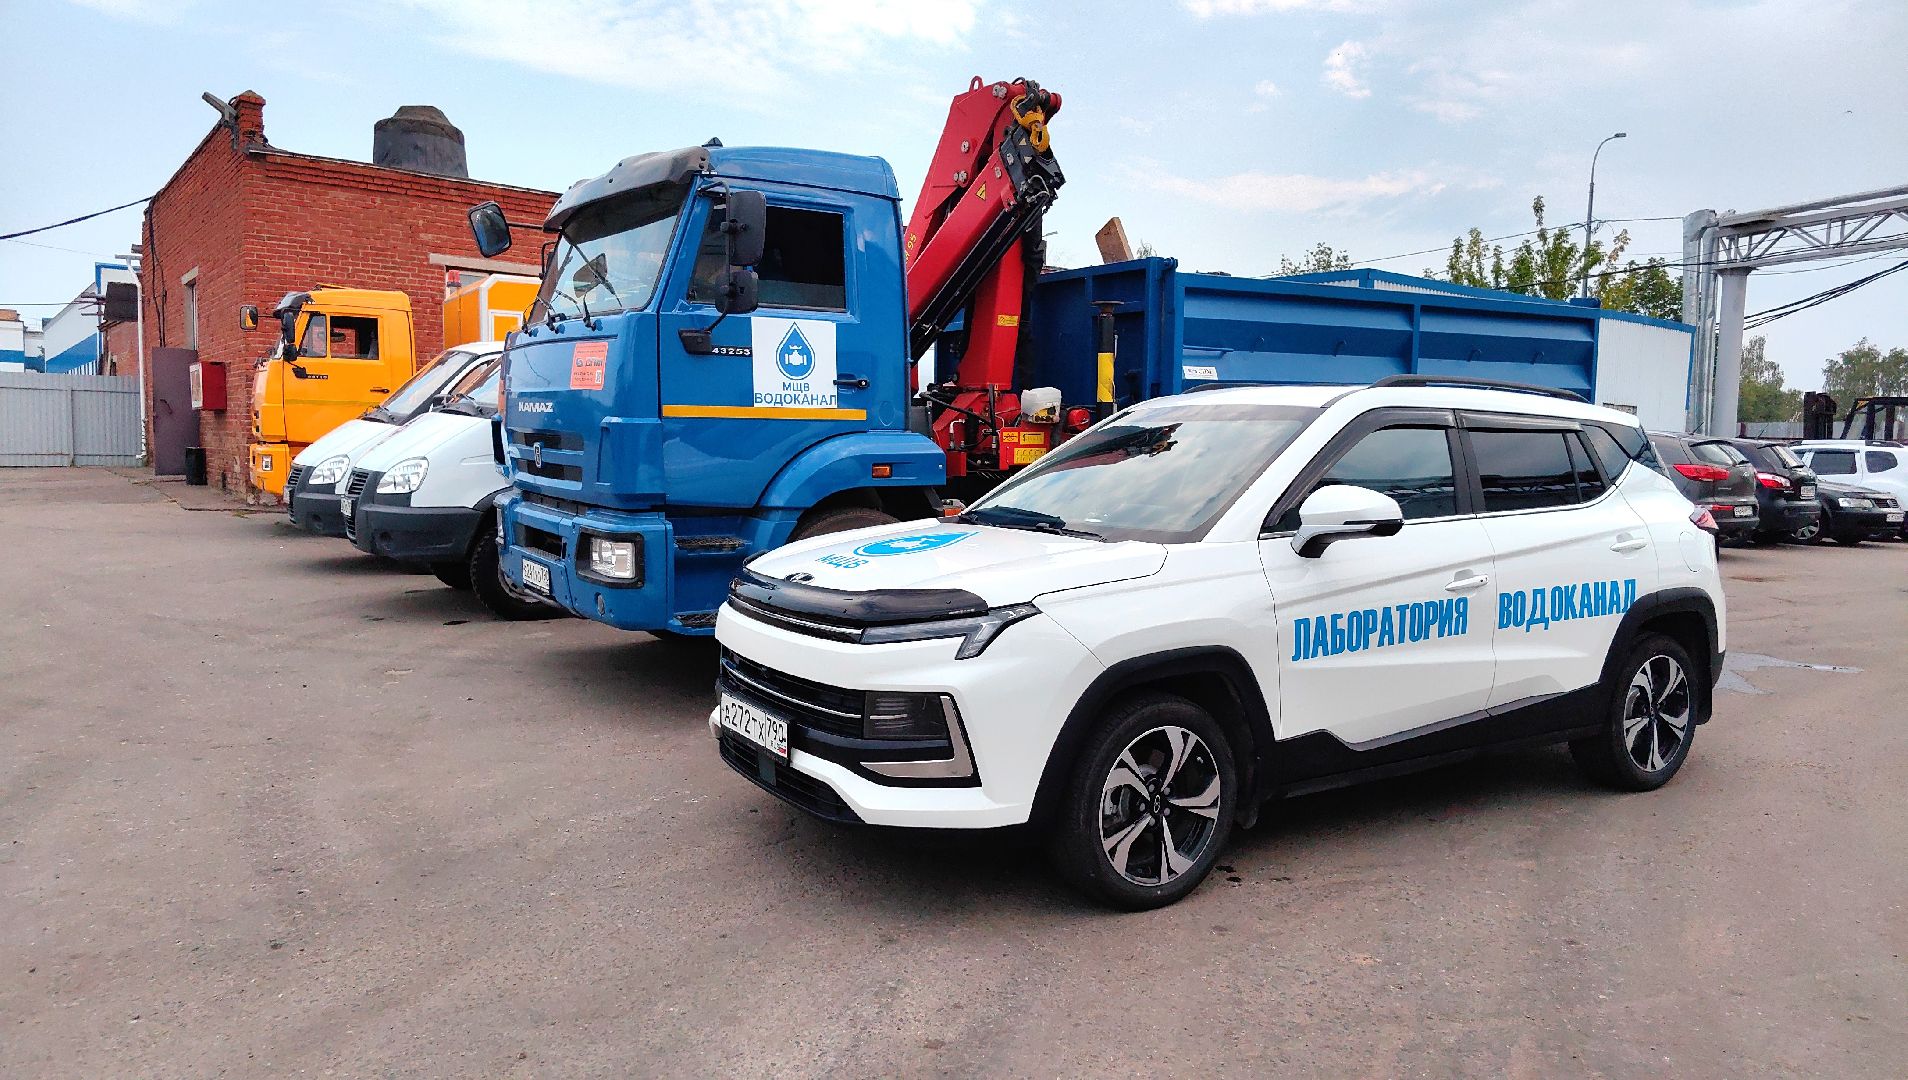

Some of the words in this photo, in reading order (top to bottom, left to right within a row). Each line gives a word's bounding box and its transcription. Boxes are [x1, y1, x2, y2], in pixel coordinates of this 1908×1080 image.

[711, 347, 751, 356] 43253
[782, 381, 811, 393] МЩВ
[754, 392, 837, 407] ВОДОКАНАЛ
[518, 401, 553, 413] KAMAZ
[1291, 596, 1469, 662] ЛАБОРАТОРИЯ
[1497, 578, 1637, 633] ВОДОКАНАЛ
